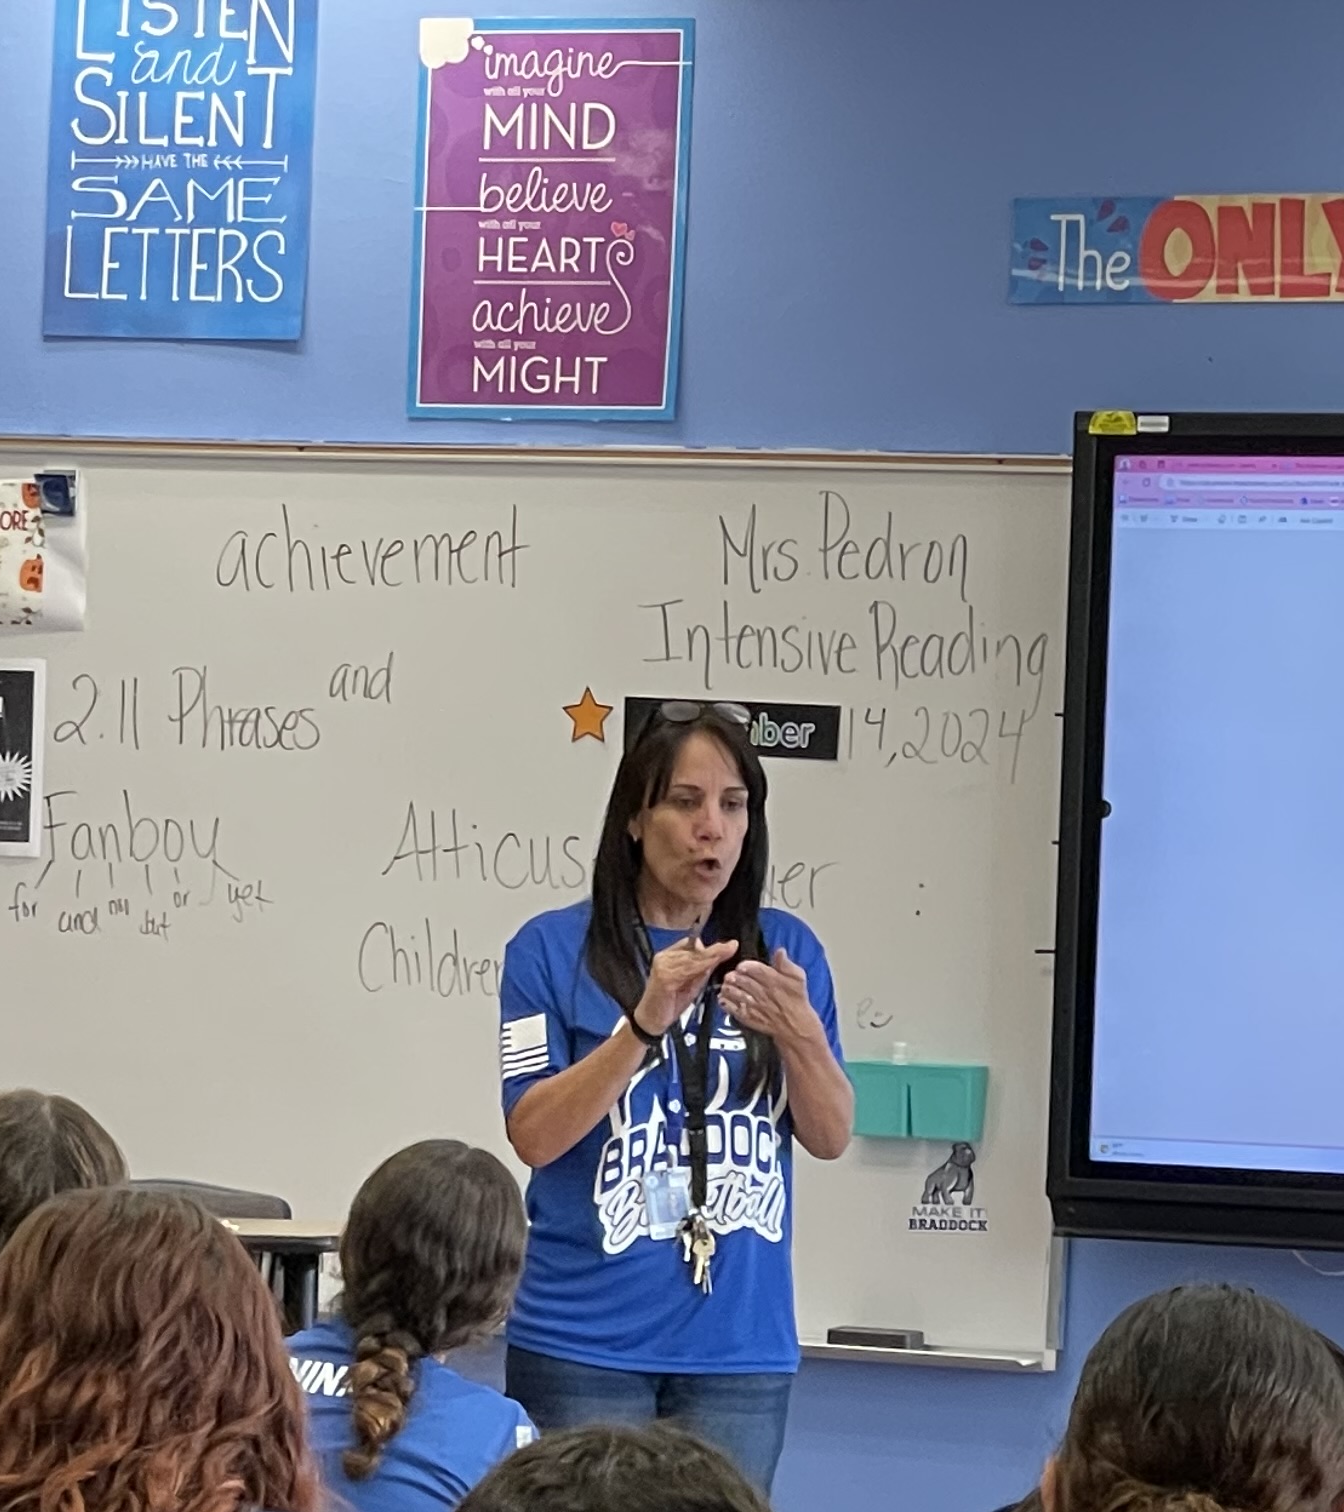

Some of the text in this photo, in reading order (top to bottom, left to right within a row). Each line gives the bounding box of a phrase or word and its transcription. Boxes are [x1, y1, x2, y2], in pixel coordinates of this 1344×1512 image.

[131, 41, 237, 85] and
[484, 47, 619, 97] imagine
[71, 66, 293, 149] SILENT
[483, 102, 616, 150] MIND
[141, 153, 209, 169] HAVE THE
[71, 176, 288, 223] SAME
[478, 166, 613, 213] believe
[64, 225, 285, 303] LETTERS
[1050, 213, 1131, 292] The
[472, 288, 618, 335] achieve
[473, 356, 608, 395] MIGHT
[216, 503, 530, 591] achievement
[819, 490, 969, 602] Pedron
[638, 599, 1048, 705] Intensive Reading
[168, 666, 321, 751] Phrases
[328, 651, 394, 703] and
[43, 789, 219, 864] Fanboy
[381, 801, 586, 890] Atticus
[8, 882, 38, 921] for
[58, 907, 100, 934] and
[173, 890, 191, 908] or
[228, 880, 274, 923] yet
[908, 1218, 988, 1231] BRADDOCK
[912, 1206, 986, 1218] MAKE IT
